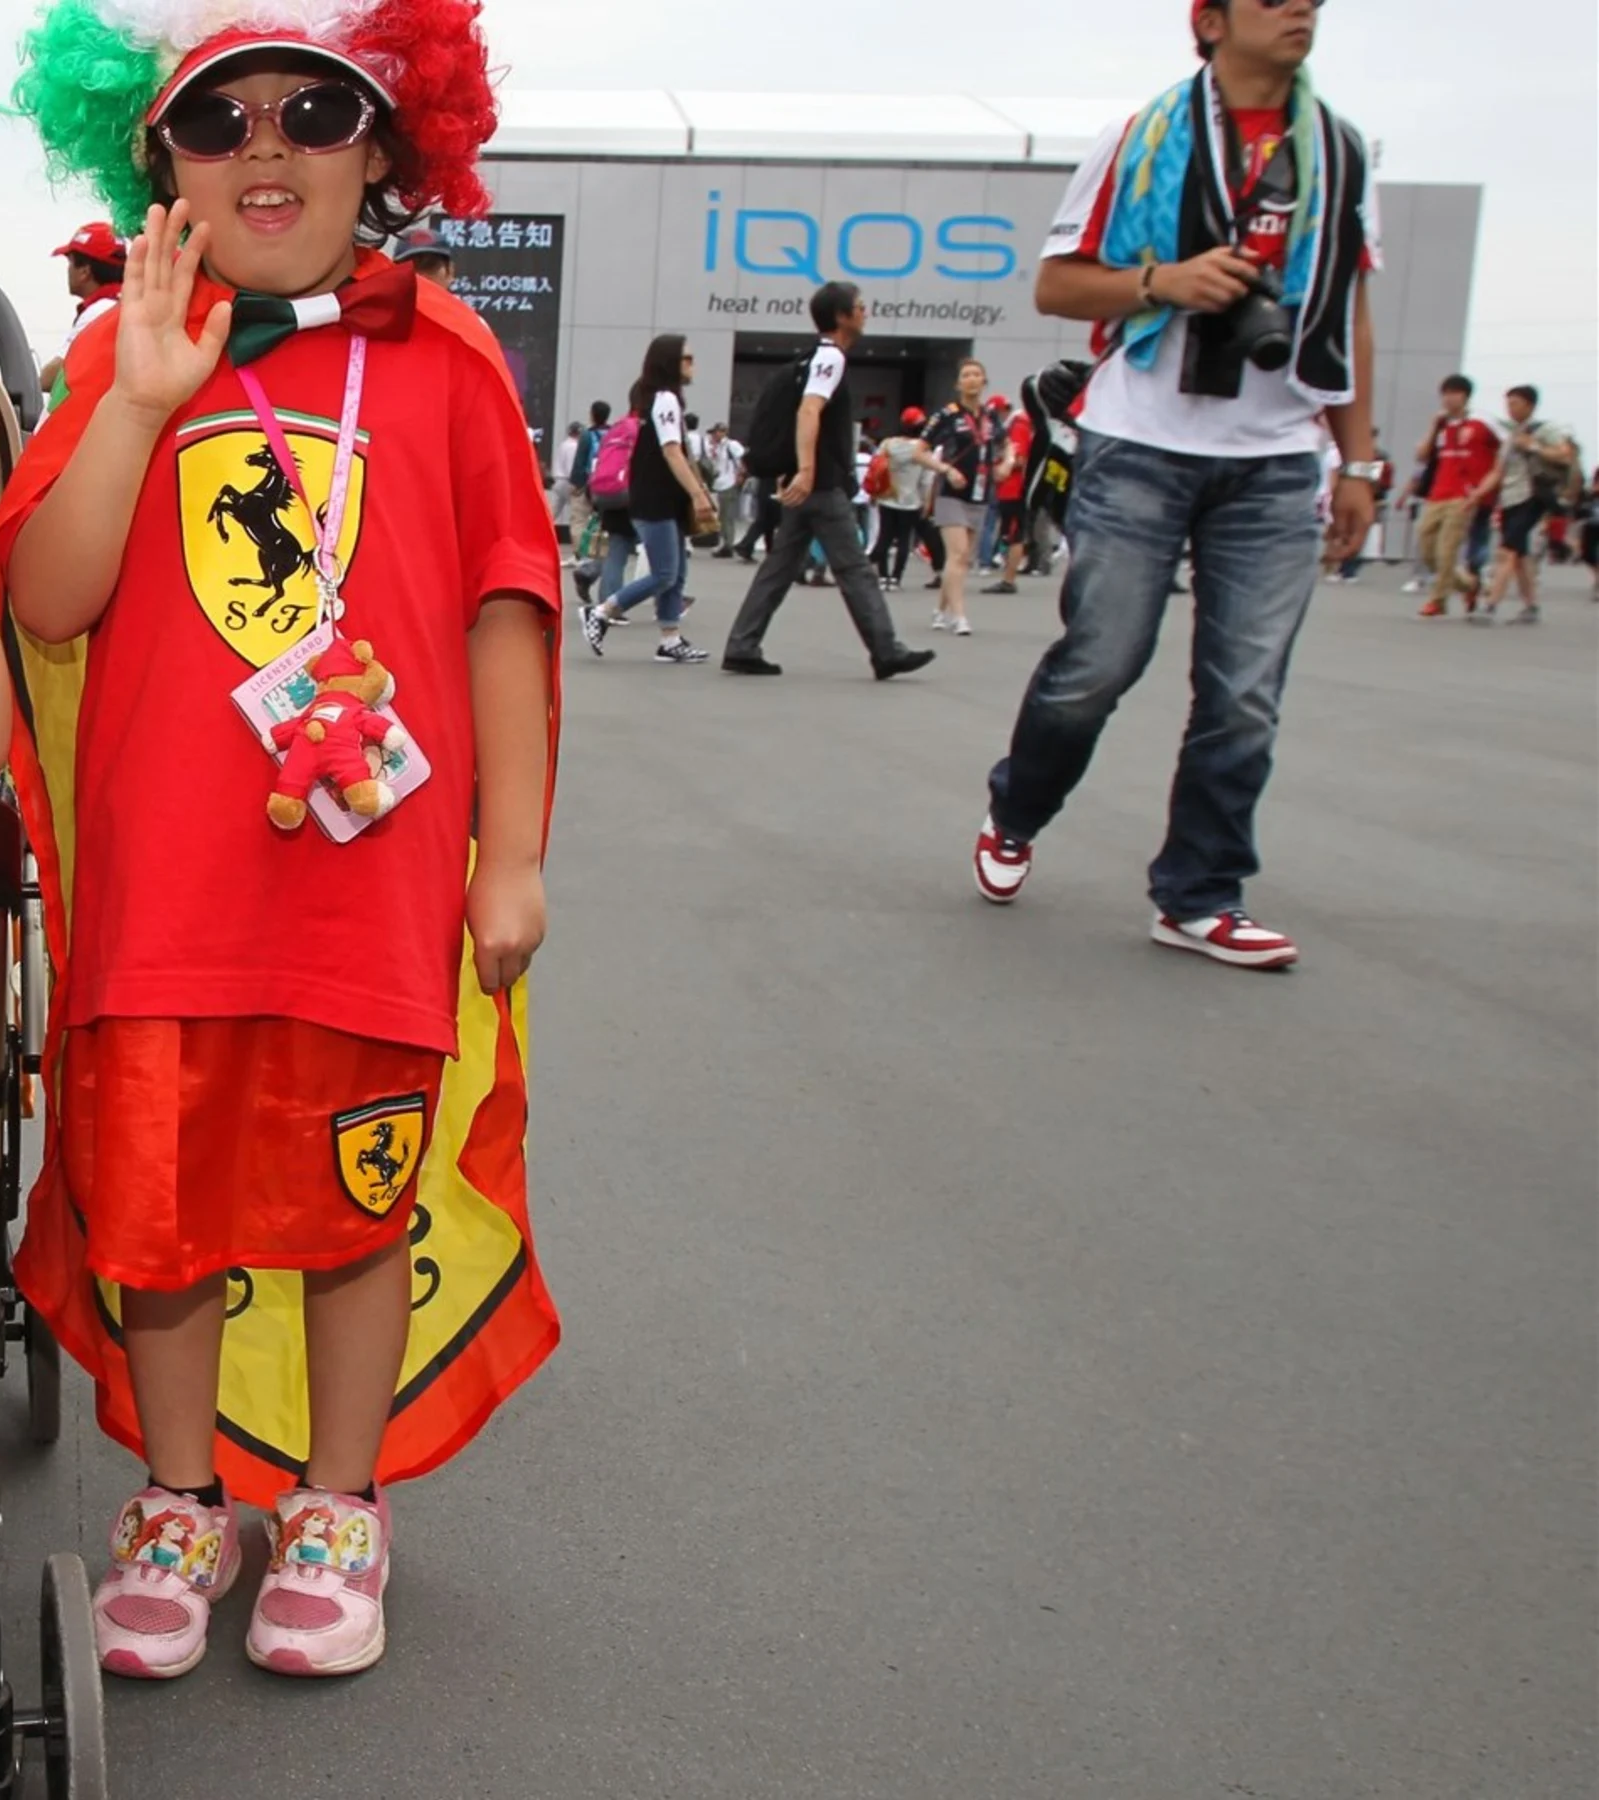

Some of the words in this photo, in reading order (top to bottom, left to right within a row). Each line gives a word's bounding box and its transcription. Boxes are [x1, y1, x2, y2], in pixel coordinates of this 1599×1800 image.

[440, 219, 553, 248] 緊急告知
[705, 189, 1017, 284] iQOS
[707, 293, 758, 314] heat
[766, 296, 804, 316] not
[871, 298, 1006, 326] technology.
[816, 363, 834, 379] 14
[659, 411, 675, 425] 14
[225, 601, 248, 631] S
[249, 657, 293, 693] LICENSE
[293, 635, 323, 659] CARD
